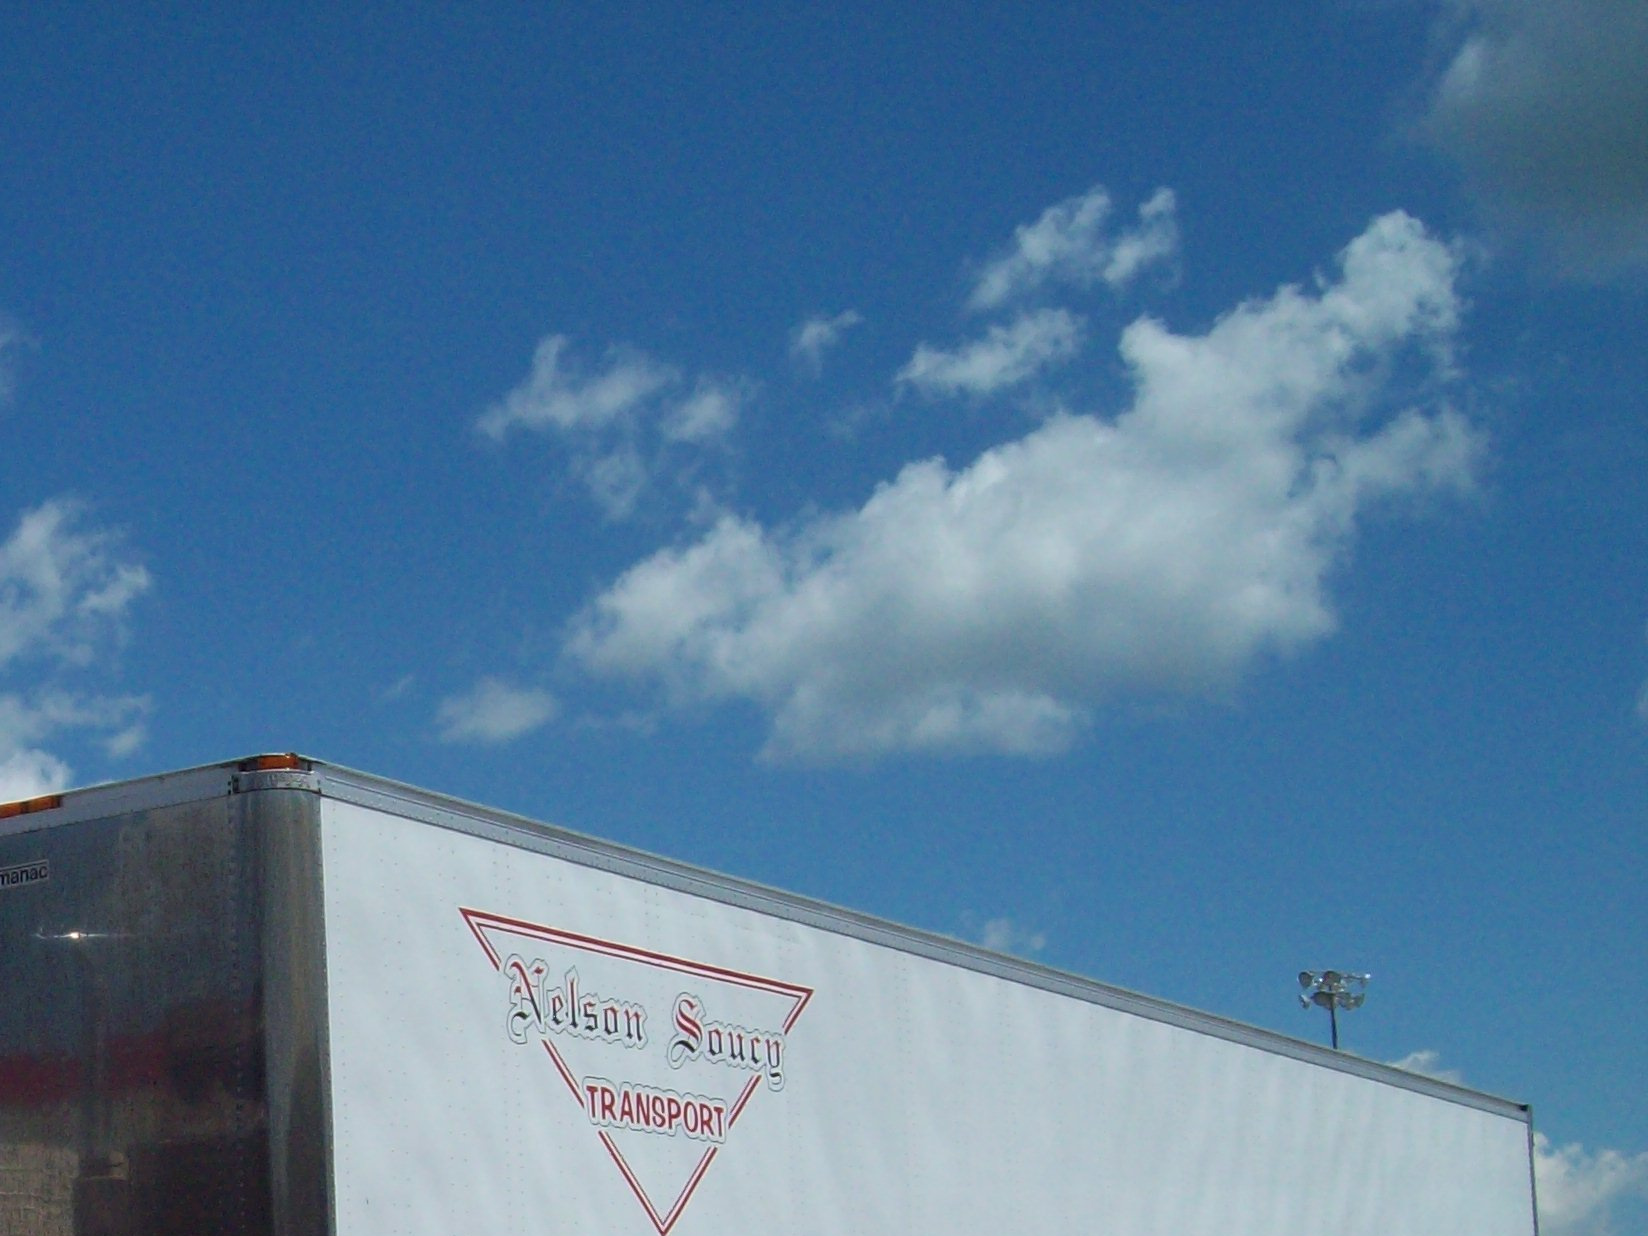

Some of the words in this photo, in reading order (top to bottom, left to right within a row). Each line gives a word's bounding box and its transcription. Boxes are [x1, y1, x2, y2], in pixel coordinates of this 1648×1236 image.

[506, 955, 647, 1048] Nelson
[669, 994, 784, 1090] Soucy
[585, 1084, 725, 1137] TRANSPORT
